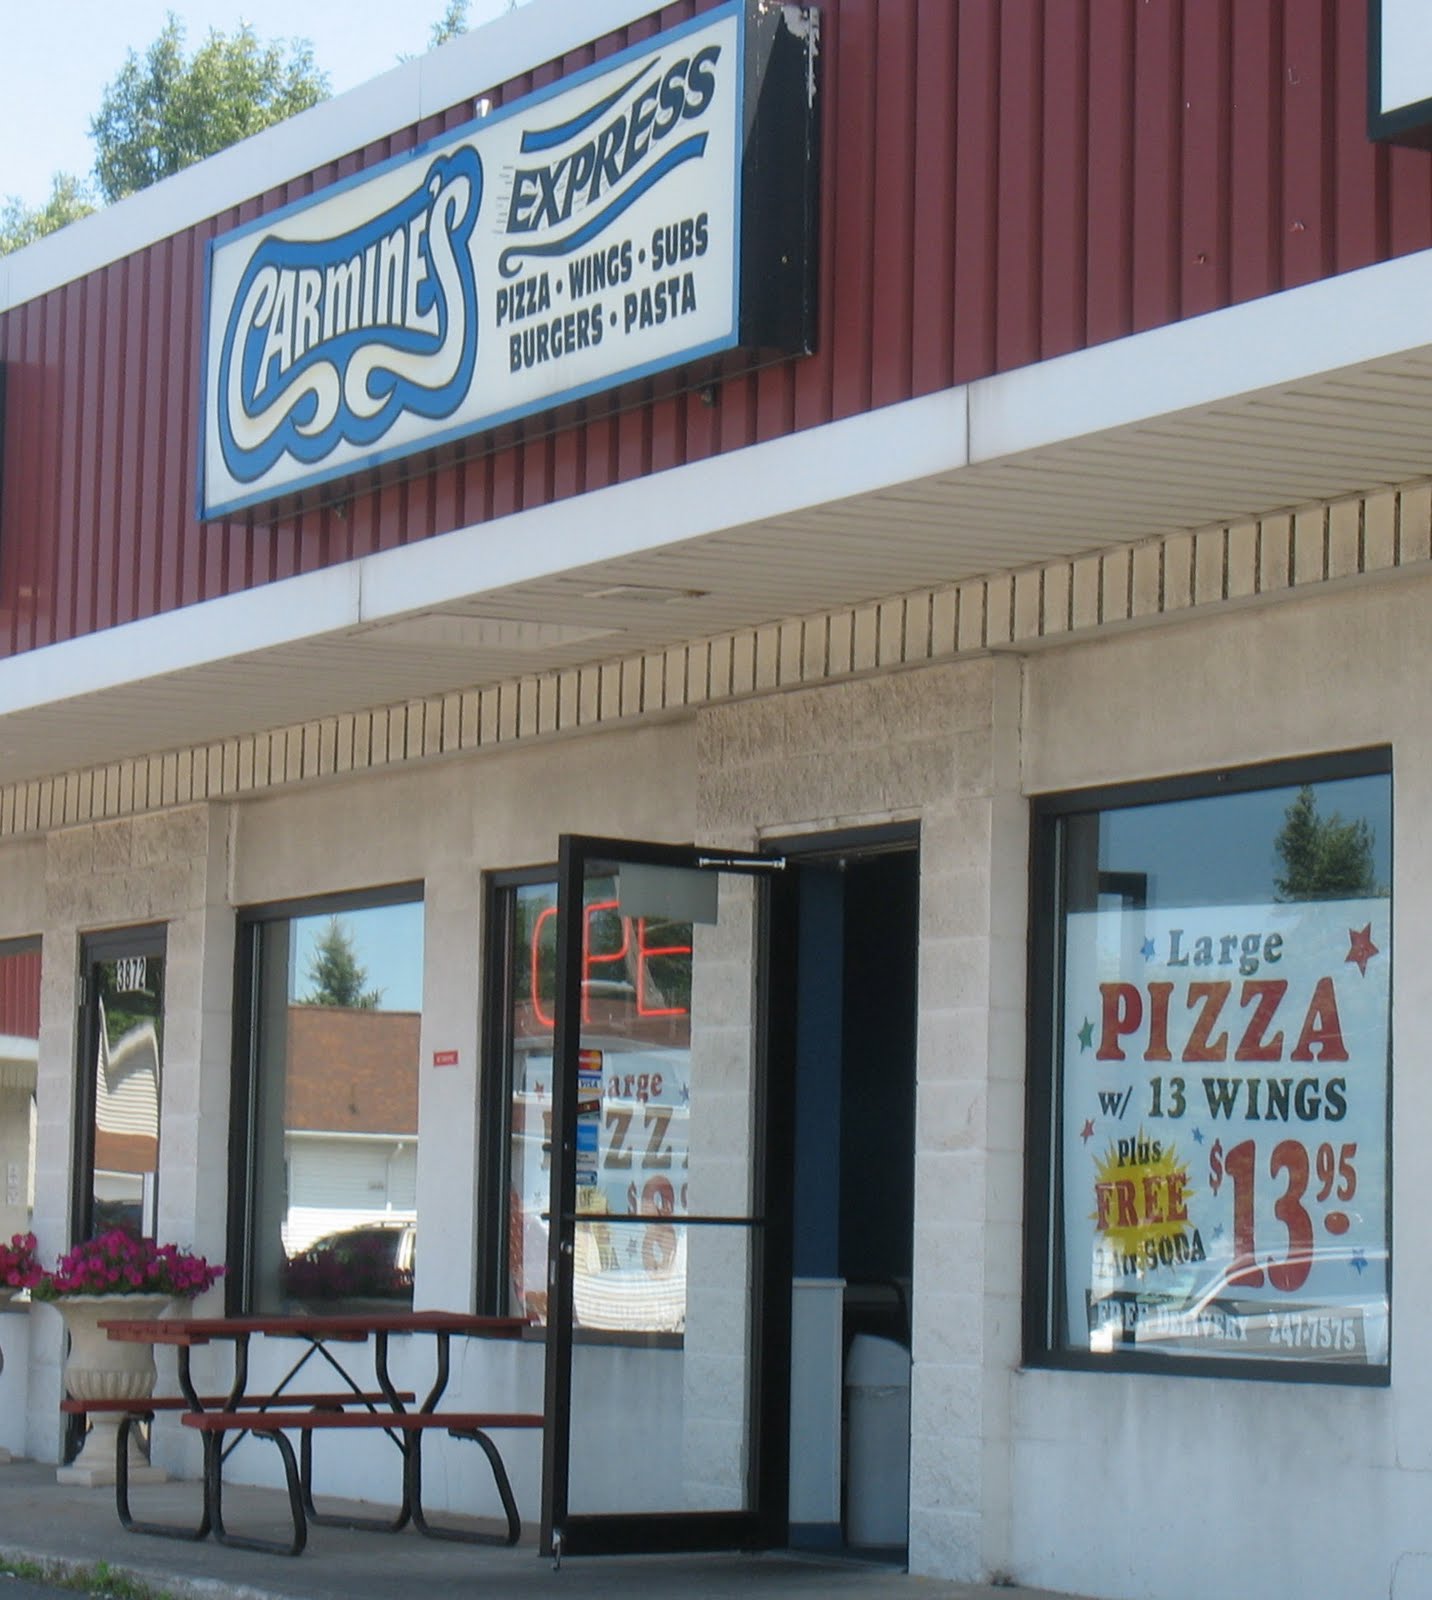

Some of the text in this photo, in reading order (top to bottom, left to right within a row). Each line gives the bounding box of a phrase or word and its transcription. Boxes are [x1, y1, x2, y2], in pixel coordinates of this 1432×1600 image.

[506, 46, 722, 233] EXPRESS
[496, 212, 708, 328] PIZZA WINGS SUBS
[510, 272, 696, 373] BURGERS PASTA
[117, 957, 146, 991] 3872
[1167, 929, 1284, 976] Large
[1096, 976, 1349, 1062] PIZZA
[603, 1072, 663, 1103] arge
[1148, 1076, 1187, 1118] 13
[1202, 1077, 1347, 1122] WINGS
[1117, 1136, 1162, 1168] Plus
[1095, 1172, 1189, 1231] FREE
[1145, 1228, 1206, 1271] SODA
